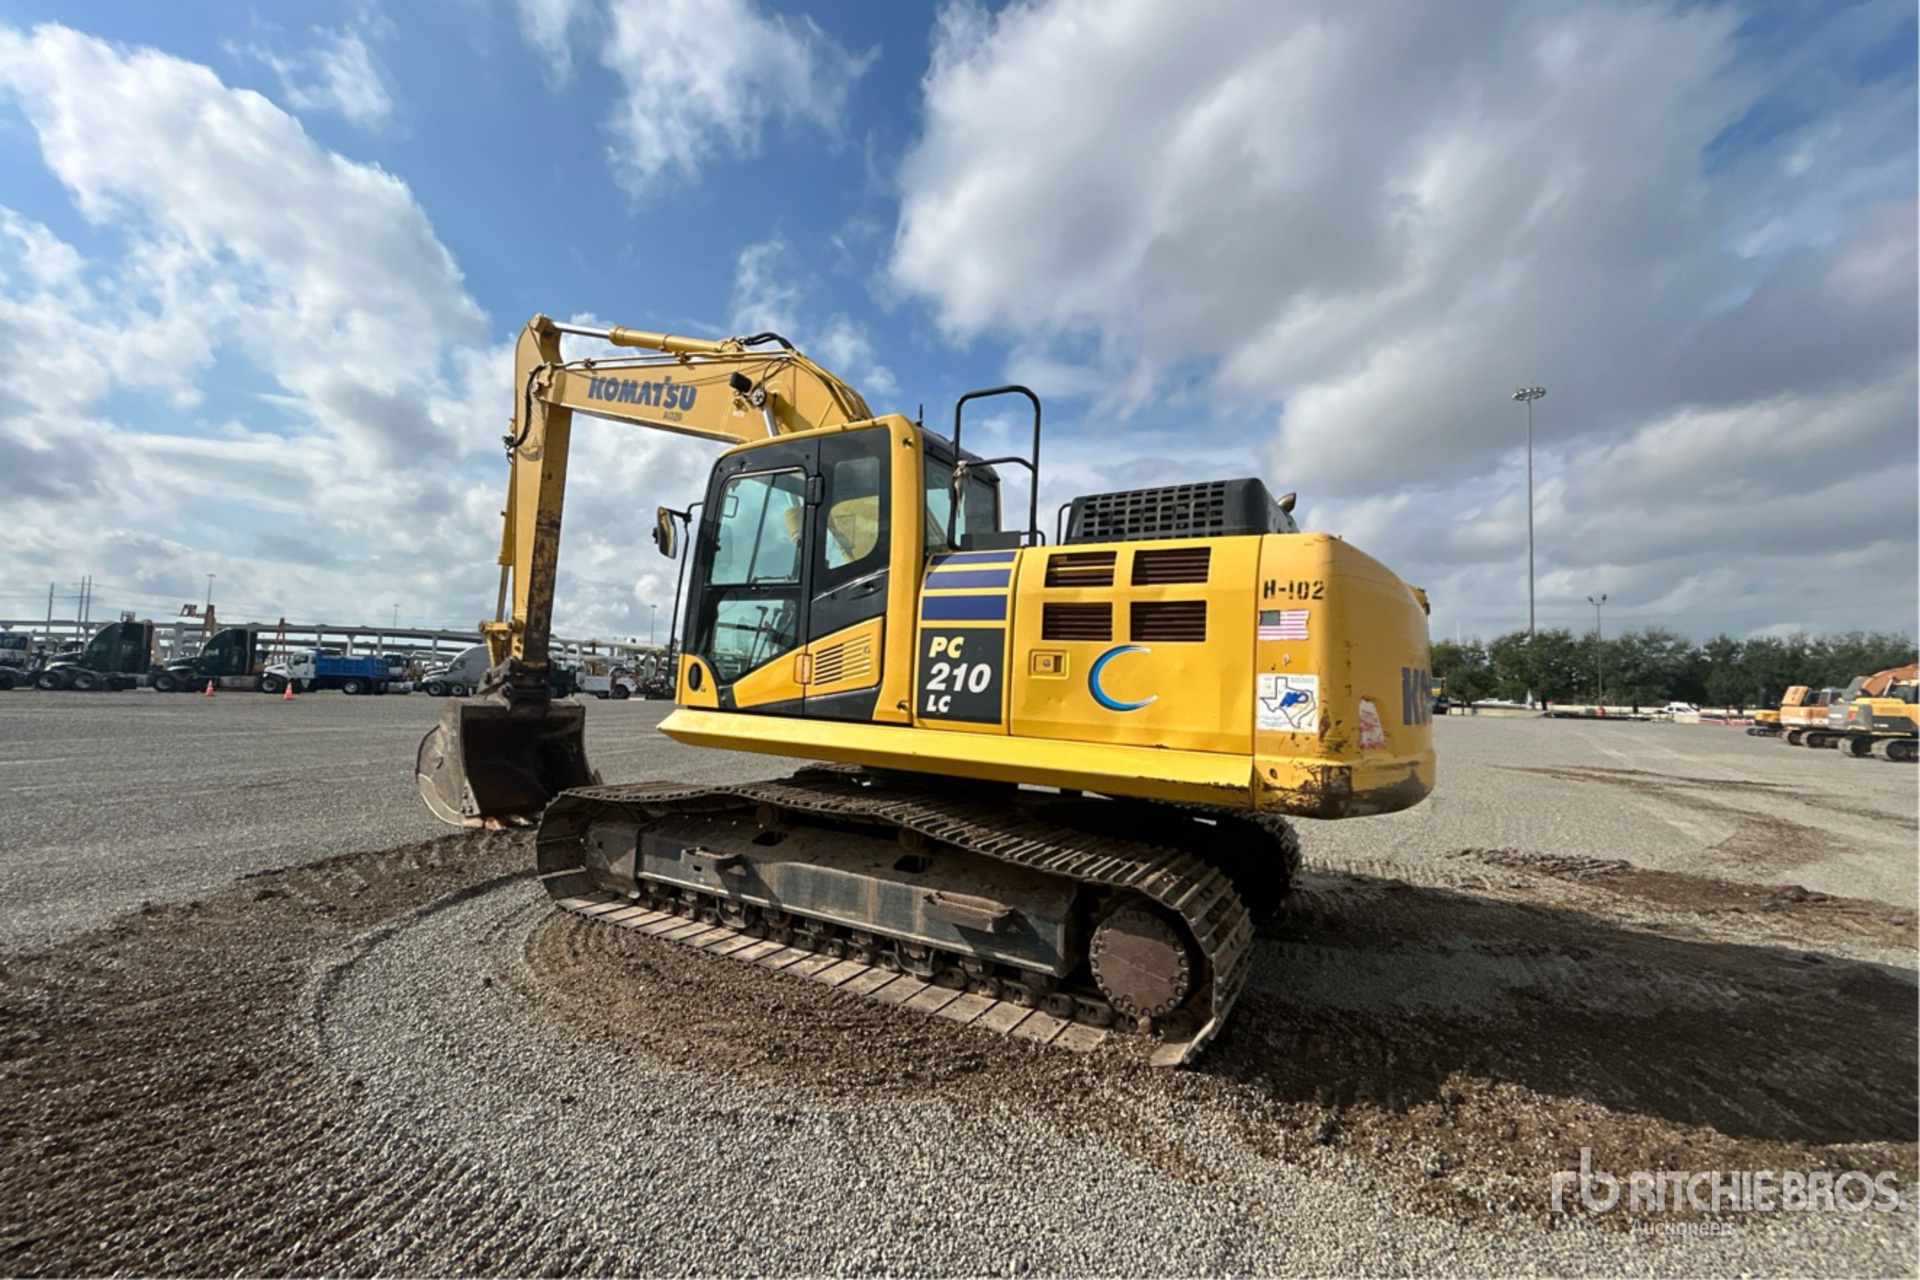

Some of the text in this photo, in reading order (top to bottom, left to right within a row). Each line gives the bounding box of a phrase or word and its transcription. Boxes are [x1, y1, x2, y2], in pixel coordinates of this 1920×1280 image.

[588, 375, 698, 411] KOMATSU
[1263, 580, 1325, 600] H-102
[928, 636, 965, 659] PC
[926, 662, 992, 694] 210
[926, 694, 952, 714] LC
